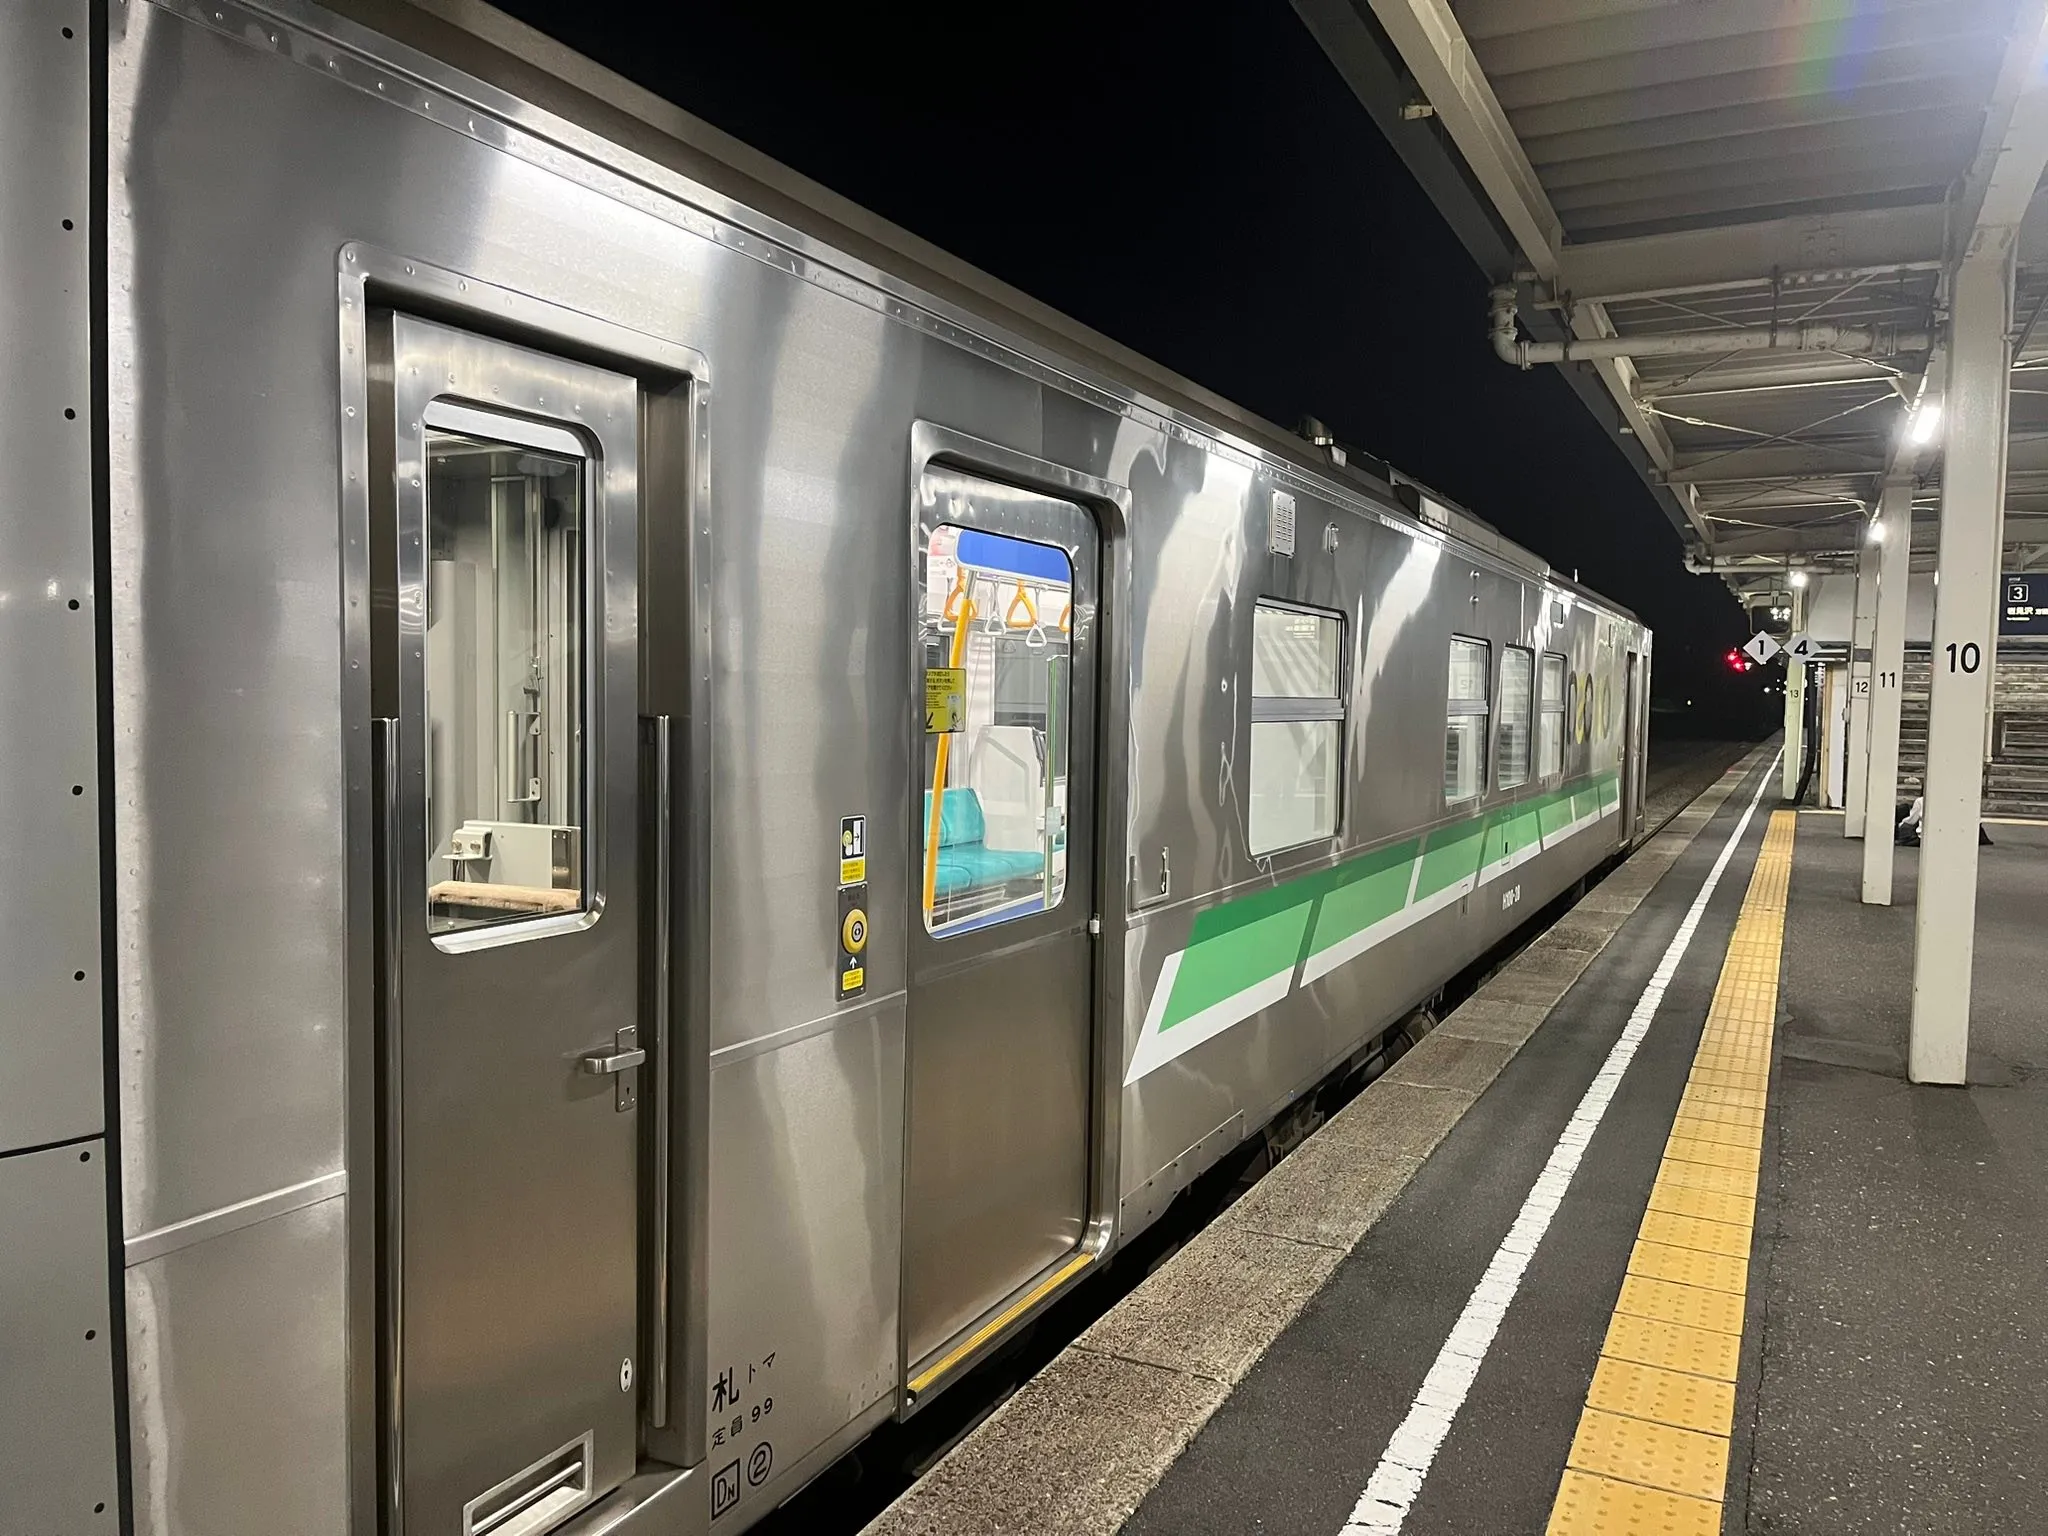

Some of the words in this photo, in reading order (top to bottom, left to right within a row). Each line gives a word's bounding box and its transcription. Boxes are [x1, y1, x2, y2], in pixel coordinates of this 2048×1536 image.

[2013, 587, 2023, 600] 3
[1758, 640, 1765, 656] 1
[1794, 640, 1809, 656] 4
[1945, 642, 1981, 674] 10
[1855, 681, 1868, 693] 12
[1879, 672, 1896, 688] 11
[1789, 690, 1799, 698] 13
[711, 1367, 740, 1413] 札
[711, 1414, 743, 1451] 定員
[751, 1397, 774, 1423] 99
